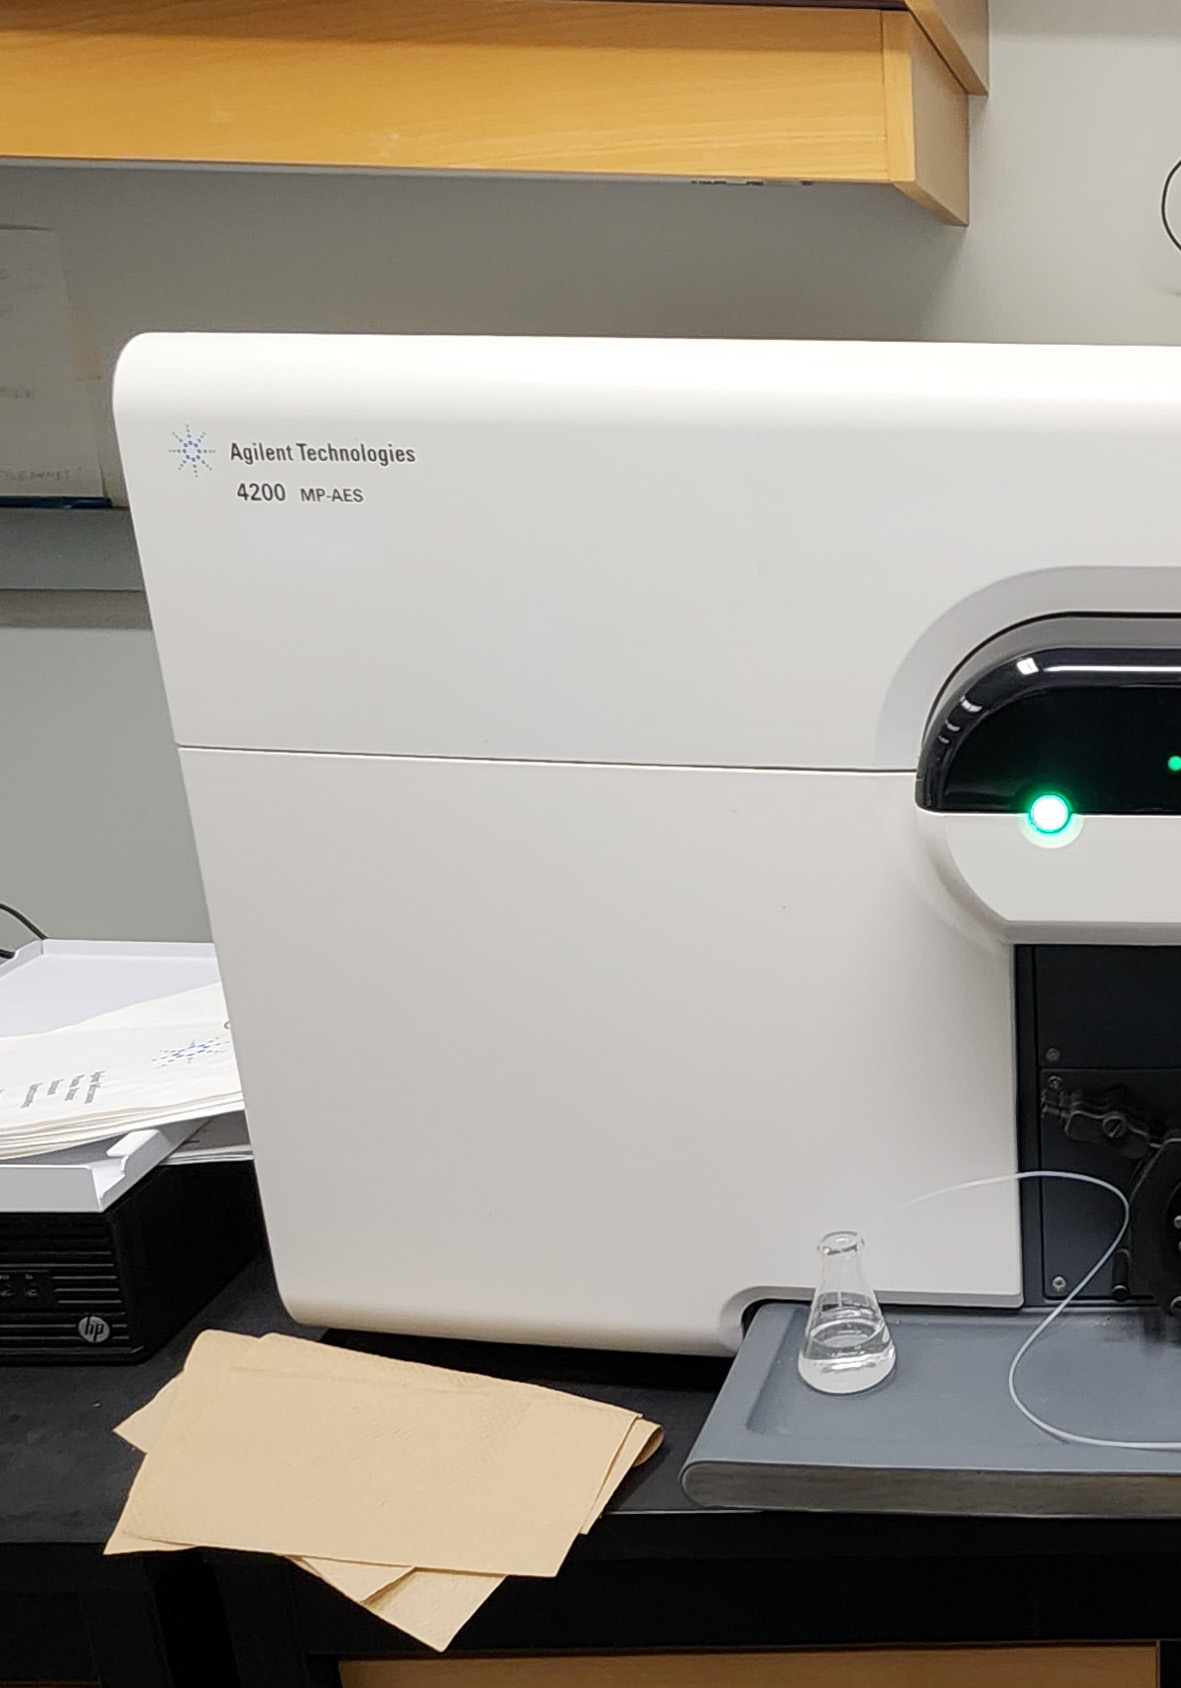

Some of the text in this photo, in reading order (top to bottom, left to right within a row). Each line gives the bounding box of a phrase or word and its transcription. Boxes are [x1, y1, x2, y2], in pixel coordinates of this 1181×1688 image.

[230, 442, 416, 467] Agilent Technologies
[236, 482, 364, 503] 4200 MP-AES
[83, 1315, 106, 1344] hp
